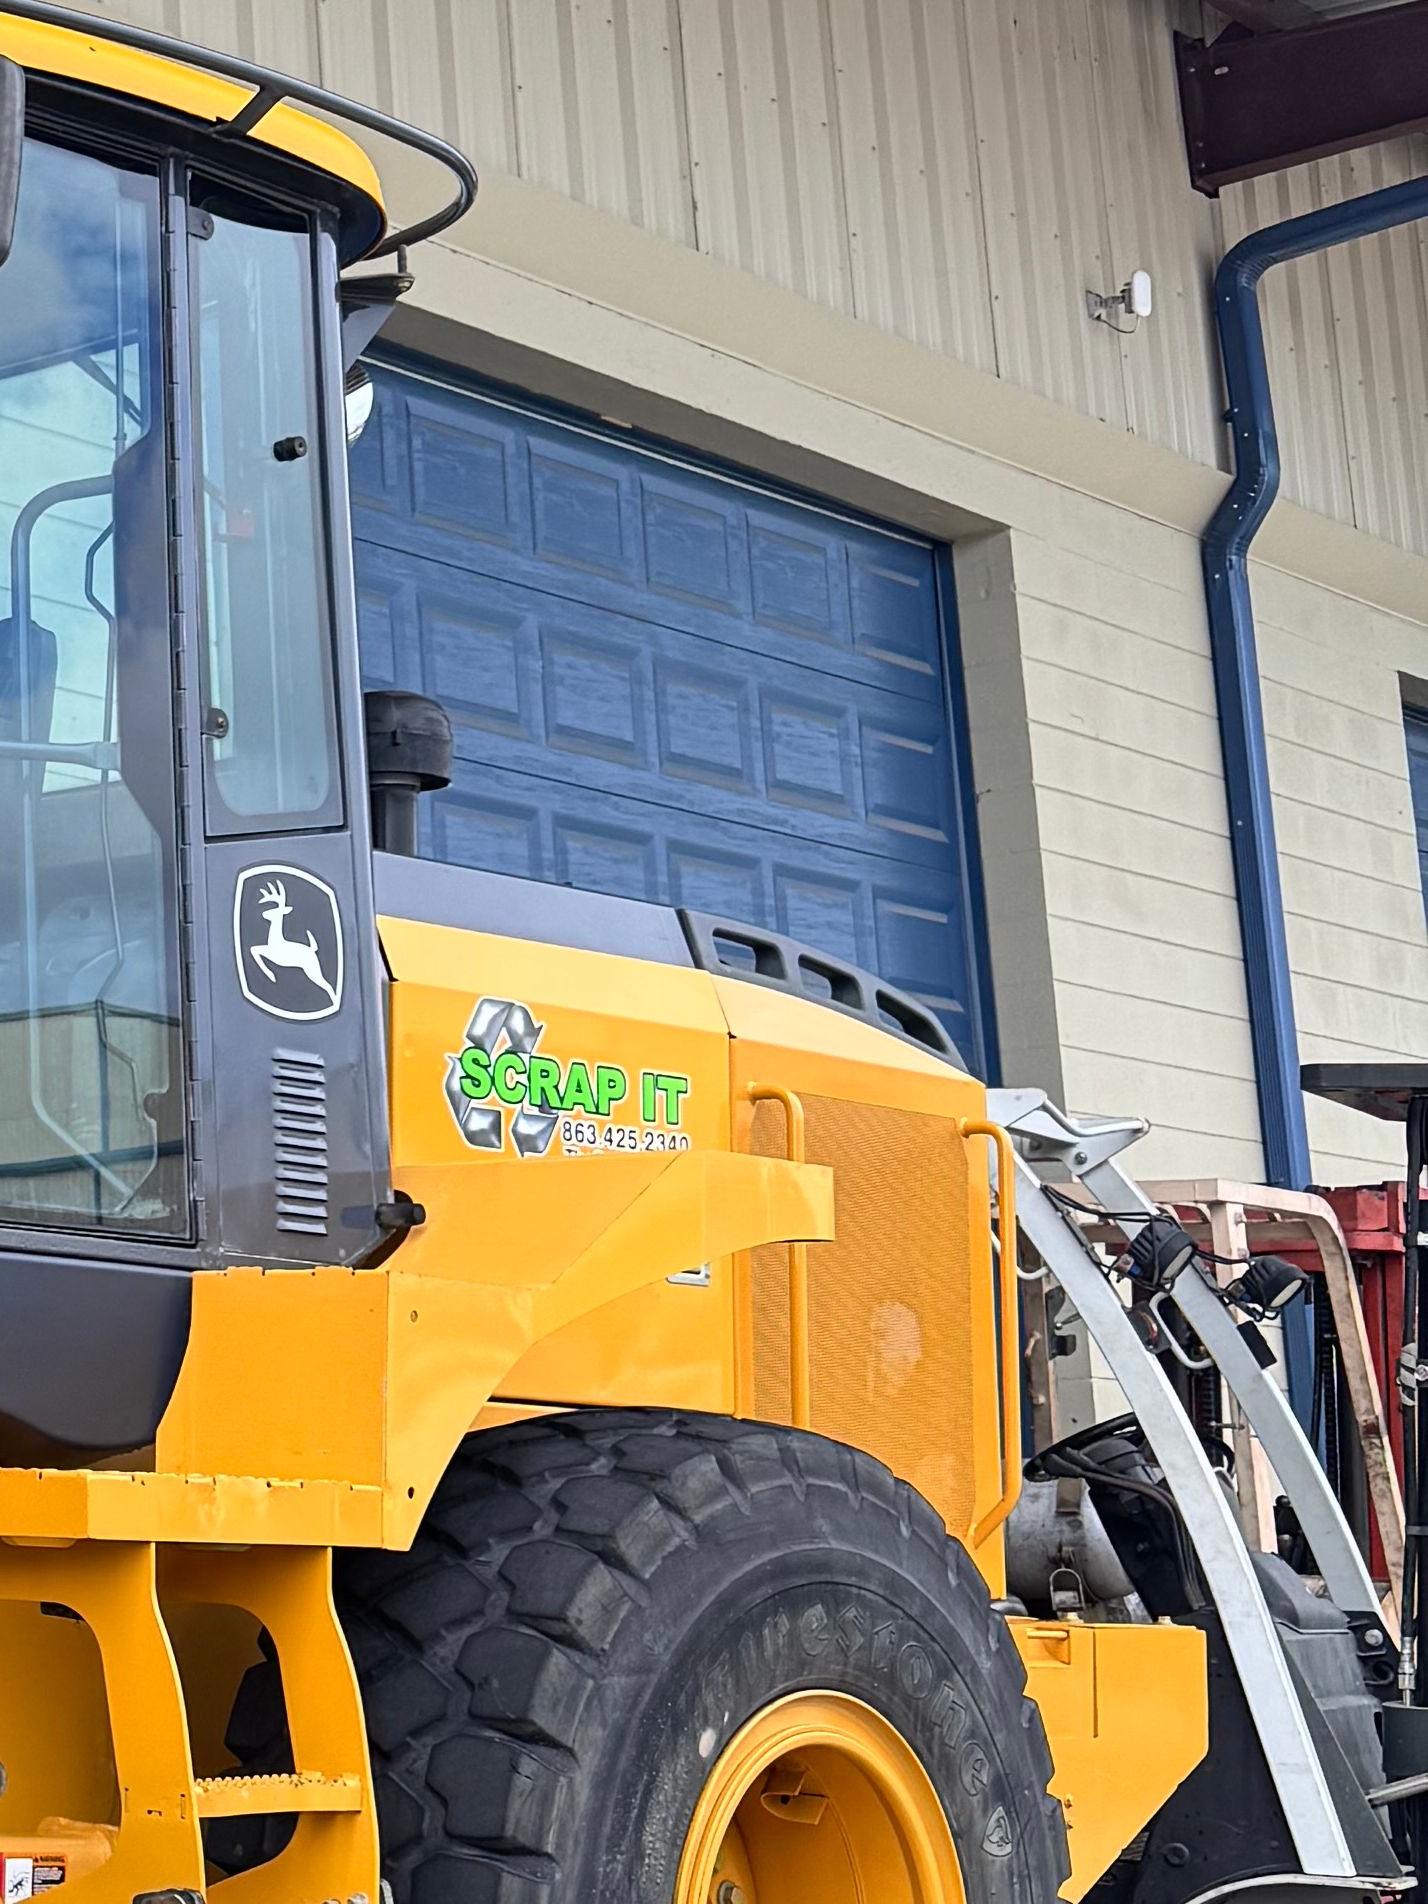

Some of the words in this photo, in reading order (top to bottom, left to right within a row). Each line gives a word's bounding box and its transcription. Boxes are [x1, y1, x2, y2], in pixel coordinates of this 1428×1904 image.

[459, 1045, 627, 1117] SCRAP
[642, 1071, 688, 1126] IT
[697, 1602, 990, 1797] Firestone
